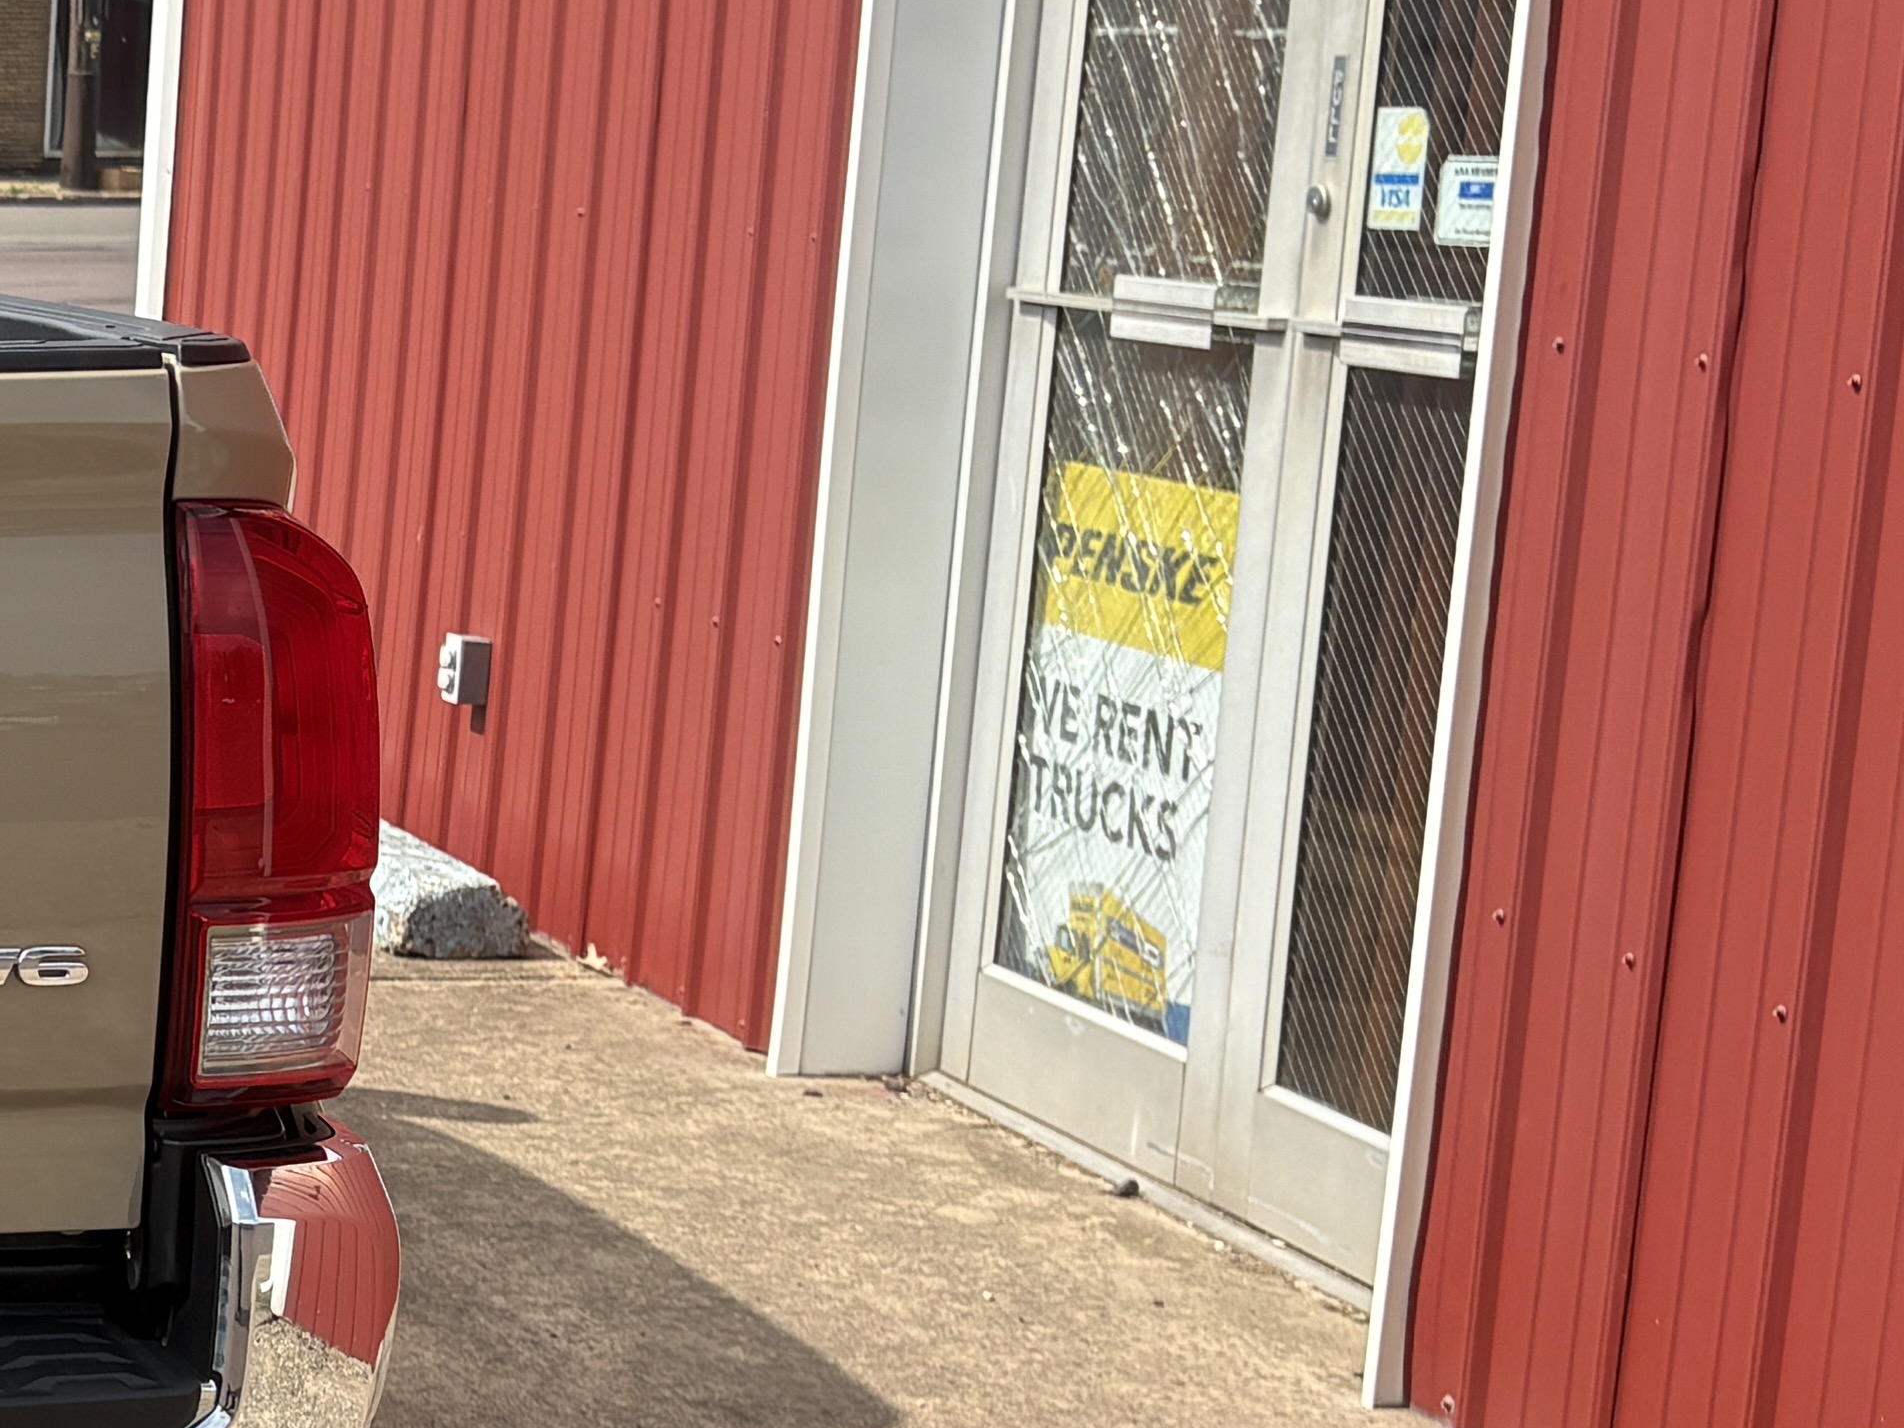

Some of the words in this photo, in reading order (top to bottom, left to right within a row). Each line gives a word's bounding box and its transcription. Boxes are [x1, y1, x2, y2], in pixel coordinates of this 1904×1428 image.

[1045, 523, 1220, 606] PENSKE
[1092, 693, 1204, 782] RENT
[1029, 755, 1180, 861] TRUCKS
